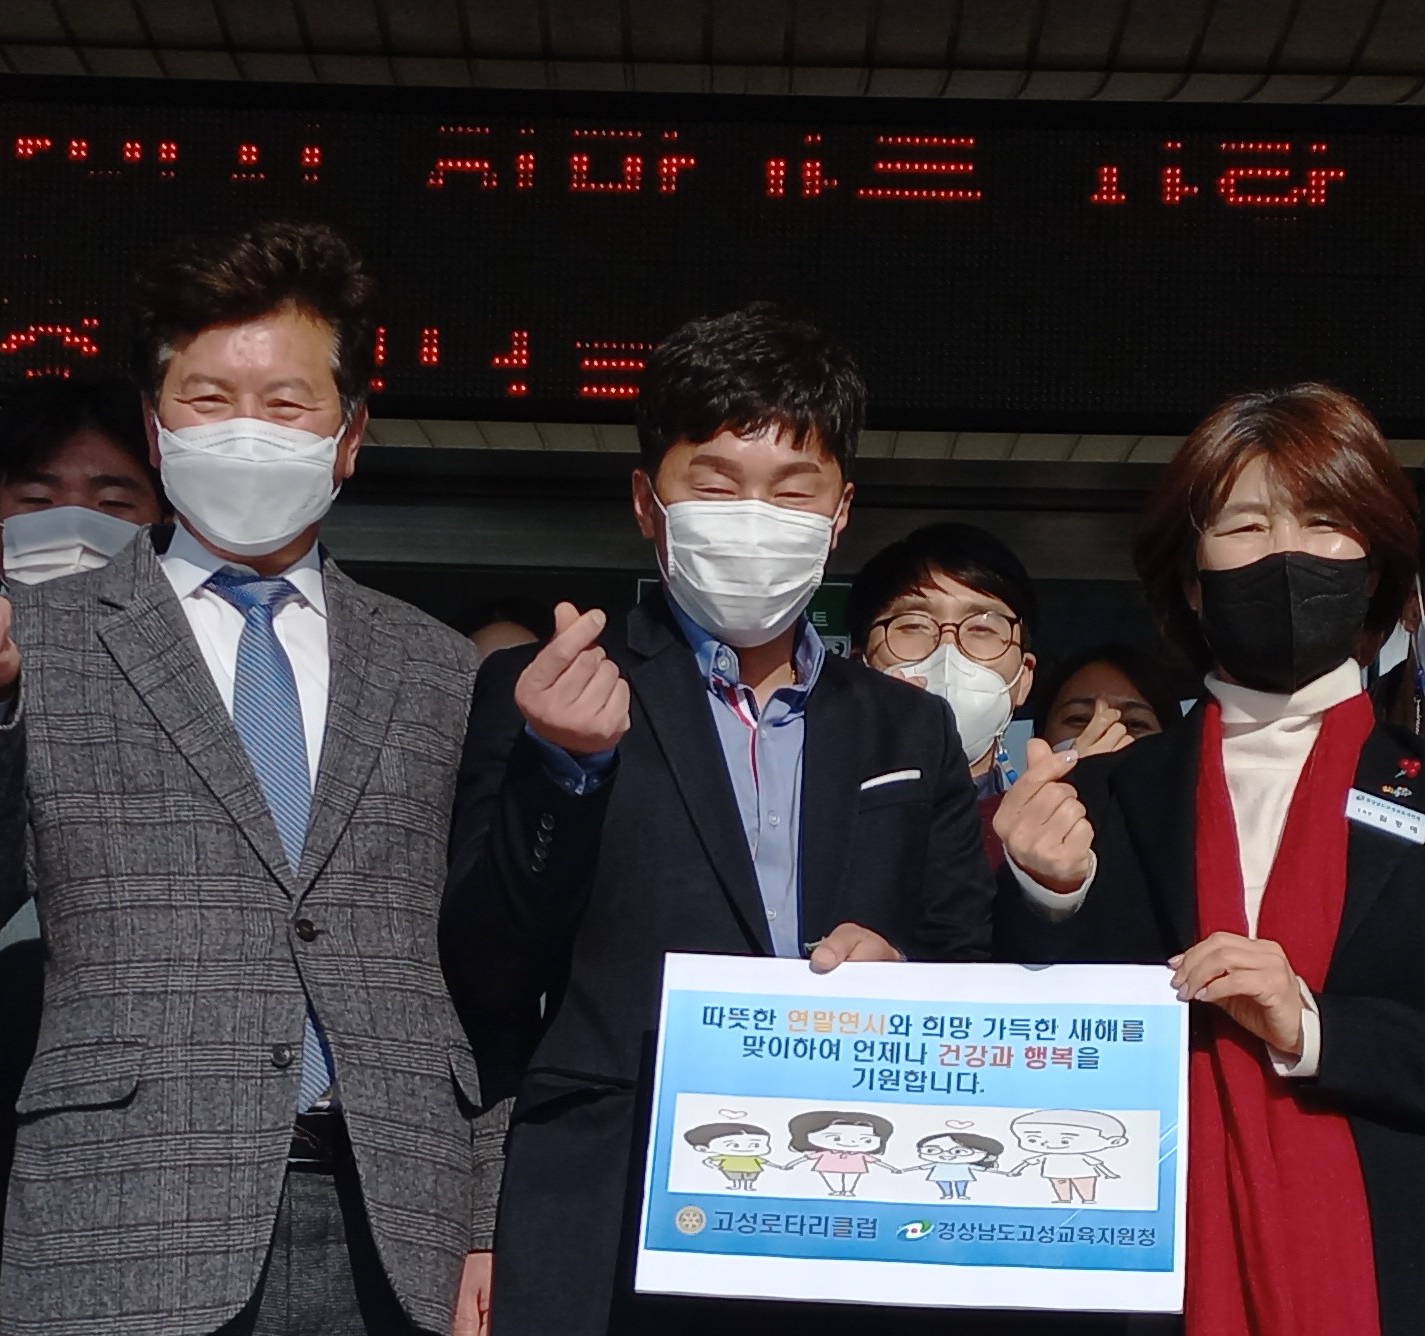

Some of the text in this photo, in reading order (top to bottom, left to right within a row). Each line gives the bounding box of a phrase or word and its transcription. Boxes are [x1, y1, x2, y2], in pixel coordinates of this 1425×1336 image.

[702, 1005, 1145, 1042] 따뜻한 연말연시와 희망 가득한 새해를
[742, 1035, 1100, 1070] 맞이하여 언제나 건강과 행복을
[852, 1067, 985, 1095] 기원합니다.
[711, 1211, 878, 1239] 고성로타리클럽
[937, 1220, 1156, 1247] 경상남도고성교육지원청
